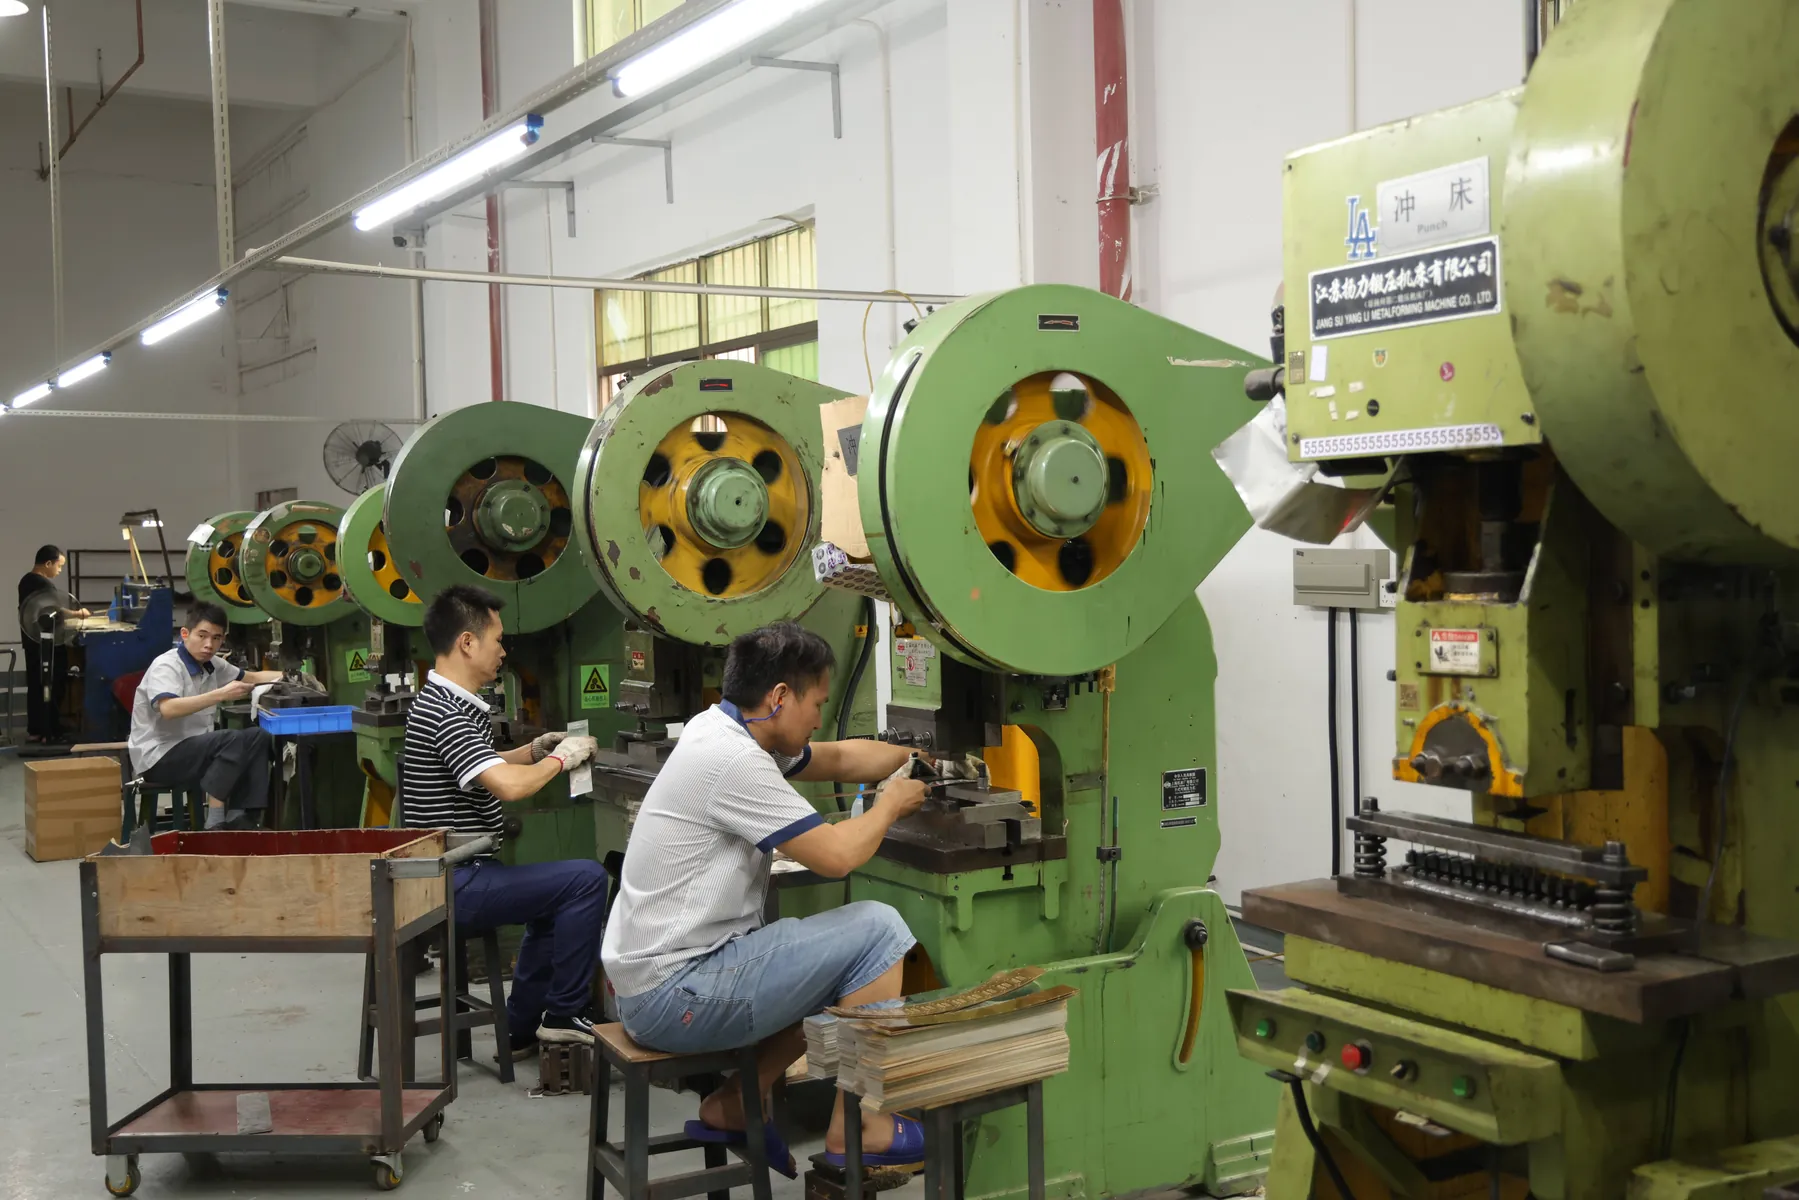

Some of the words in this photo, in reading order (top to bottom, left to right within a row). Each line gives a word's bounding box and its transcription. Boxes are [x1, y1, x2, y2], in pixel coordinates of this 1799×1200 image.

[1345, 197, 1376, 258] LA
[1417, 219, 1448, 234] Punch
[1316, 316, 1333, 330] JIANG
[1334, 315, 1343, 327] SU
[1345, 311, 1362, 324] YANG
[1363, 310, 1370, 322] LI
[1371, 301, 1423, 320] METALFORMING
[1424, 295, 1457, 312] MACHINE
